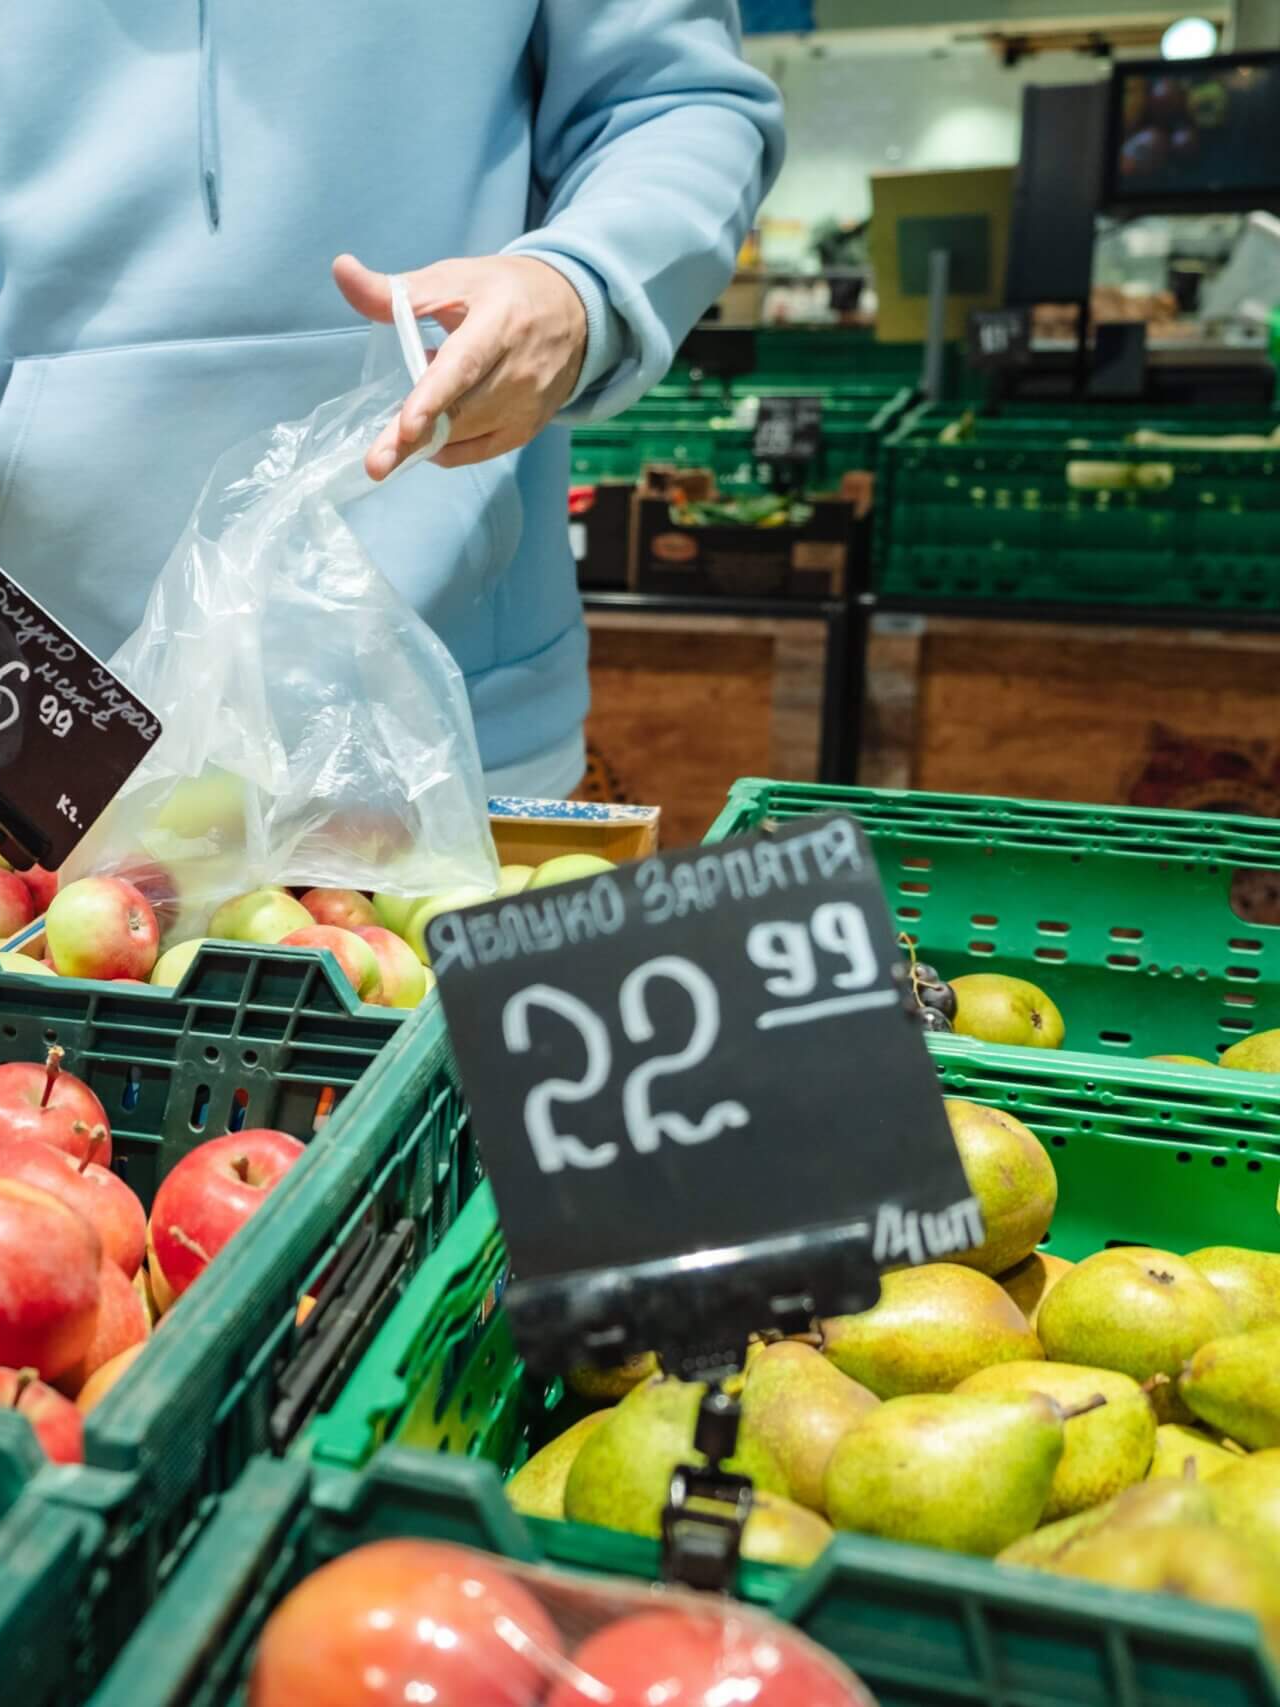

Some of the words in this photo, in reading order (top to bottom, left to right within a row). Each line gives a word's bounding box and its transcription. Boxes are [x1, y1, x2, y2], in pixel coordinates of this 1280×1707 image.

[39, 694, 73, 738] 99
[429, 875, 625, 976] ЯБЛУКО
[502, 955, 750, 1173] 22
[746, 901, 879, 998] 99
